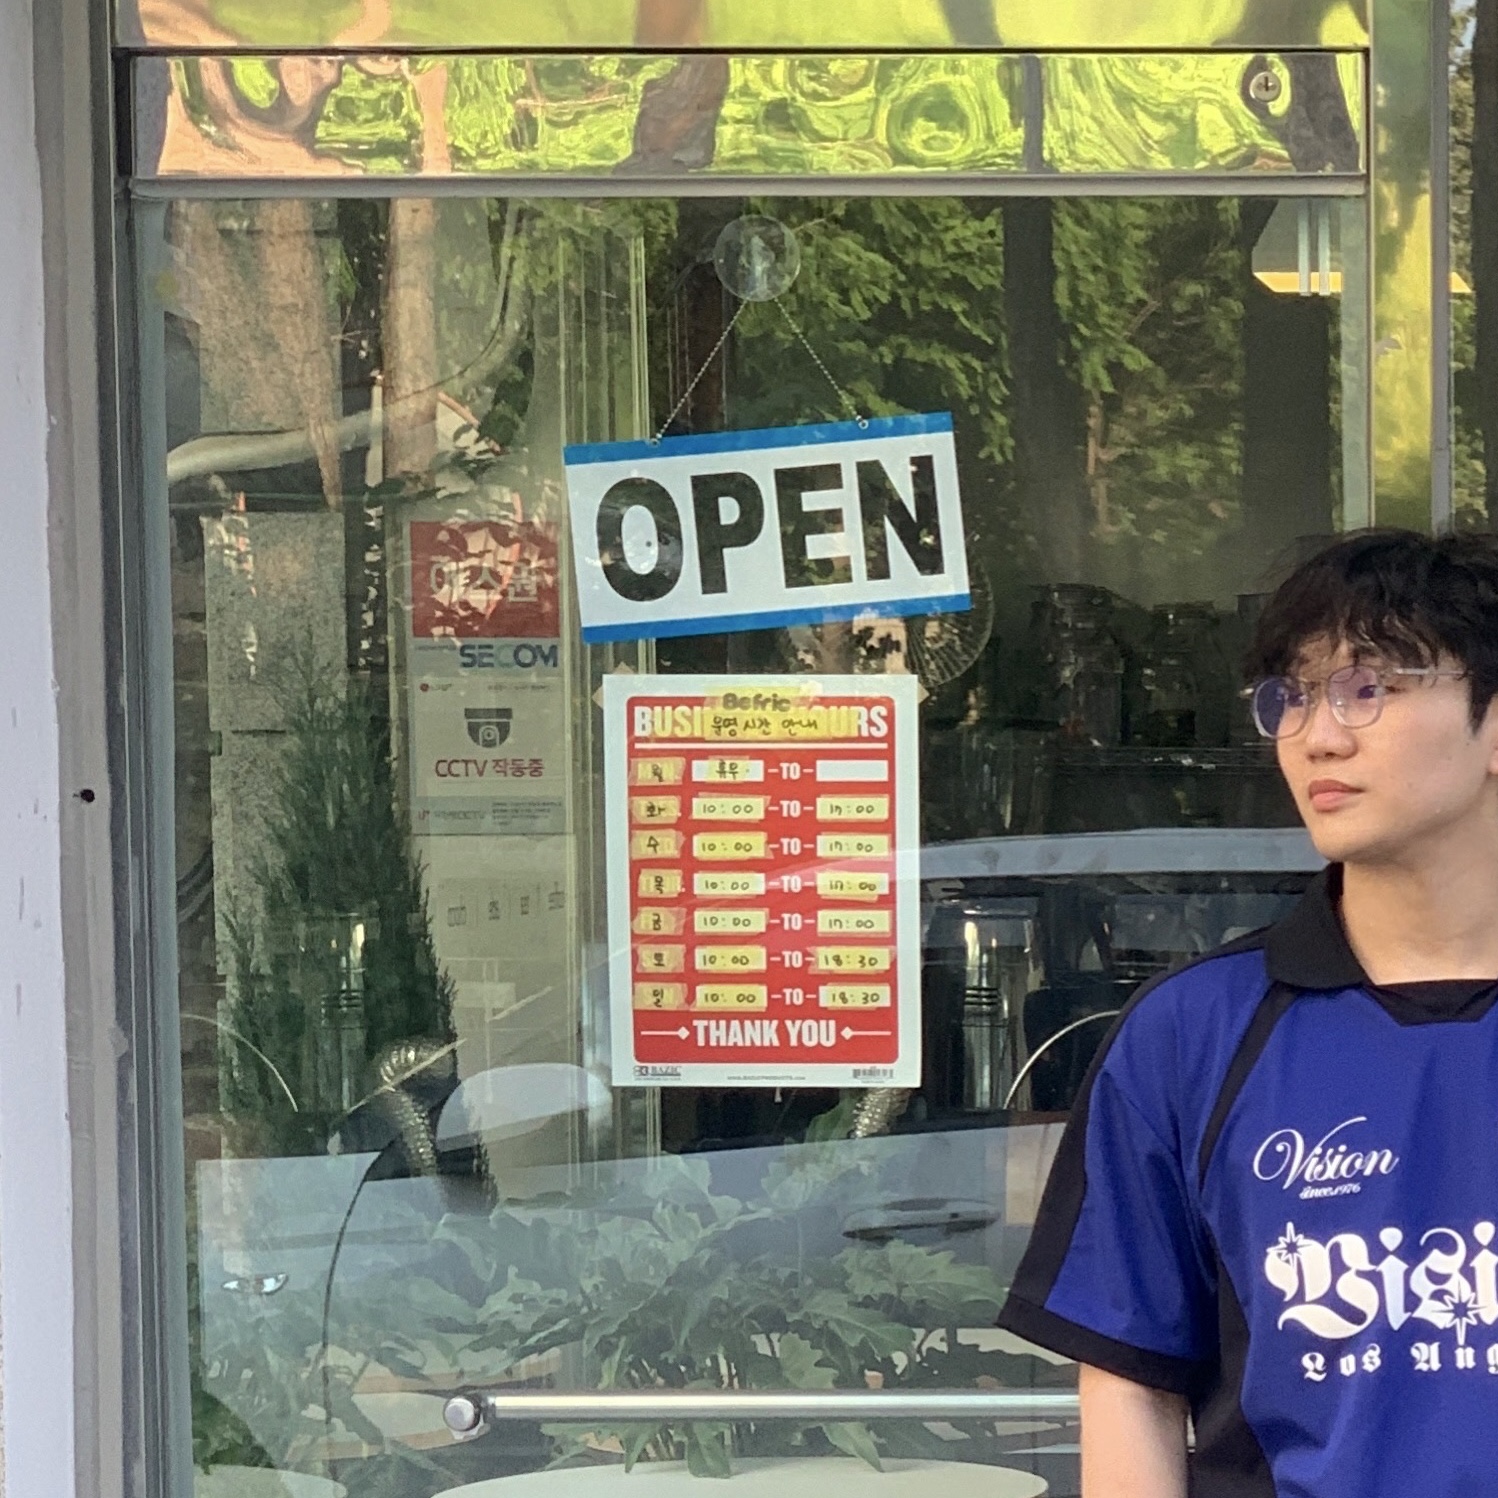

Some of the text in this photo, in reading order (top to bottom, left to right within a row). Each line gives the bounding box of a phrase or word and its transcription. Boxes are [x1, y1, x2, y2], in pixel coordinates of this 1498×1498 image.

[595, 454, 946, 603] OPEN
[459, 643, 558, 668] SECOM
[722, 692, 791, 713] Befric
[435, 758, 545, 778] CCTV 작동중
[693, 1019, 837, 1047] THANK YOU
[1253, 1116, 1400, 1190] Vision
[1302, 1344, 1382, 1382] Los
